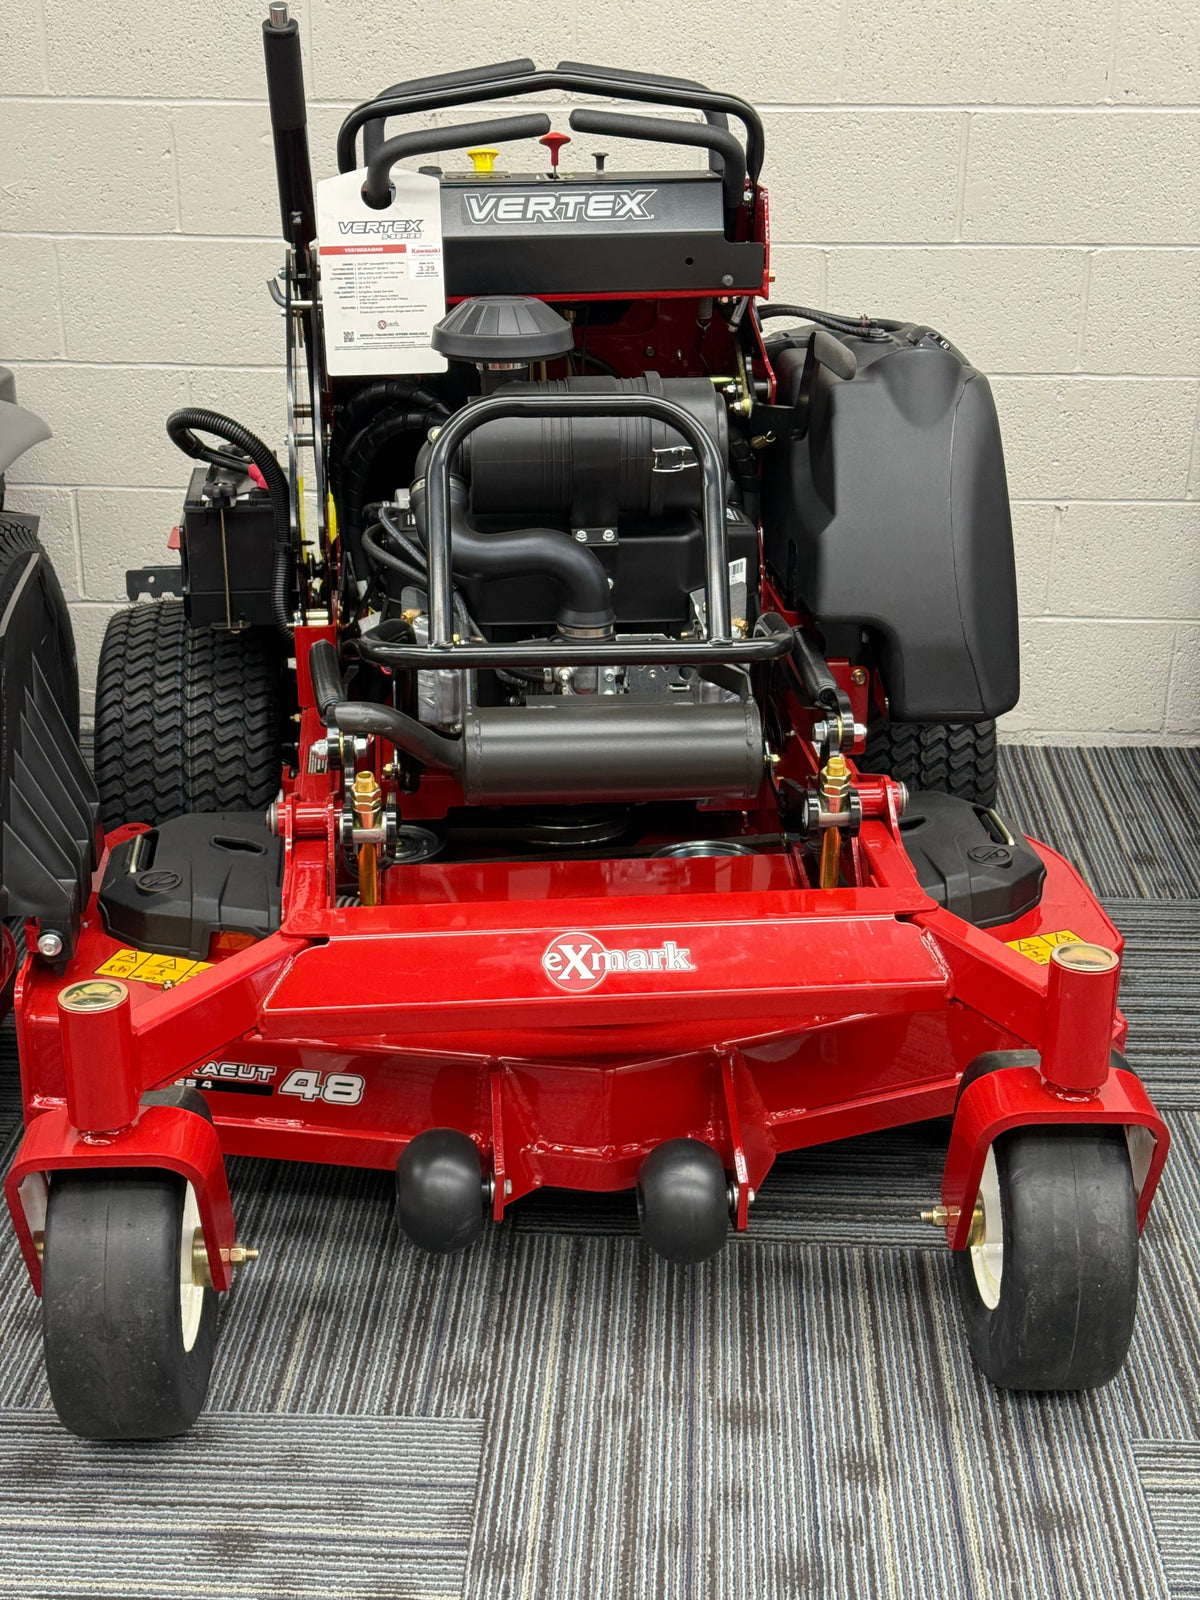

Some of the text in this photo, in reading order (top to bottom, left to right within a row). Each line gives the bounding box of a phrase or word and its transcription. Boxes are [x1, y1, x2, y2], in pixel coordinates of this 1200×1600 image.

[464, 189, 658, 224] VERTEX
[338, 219, 424, 234] VERTEX
[201, 1079, 213, 1089] 4
[278, 1069, 366, 1106] 48
